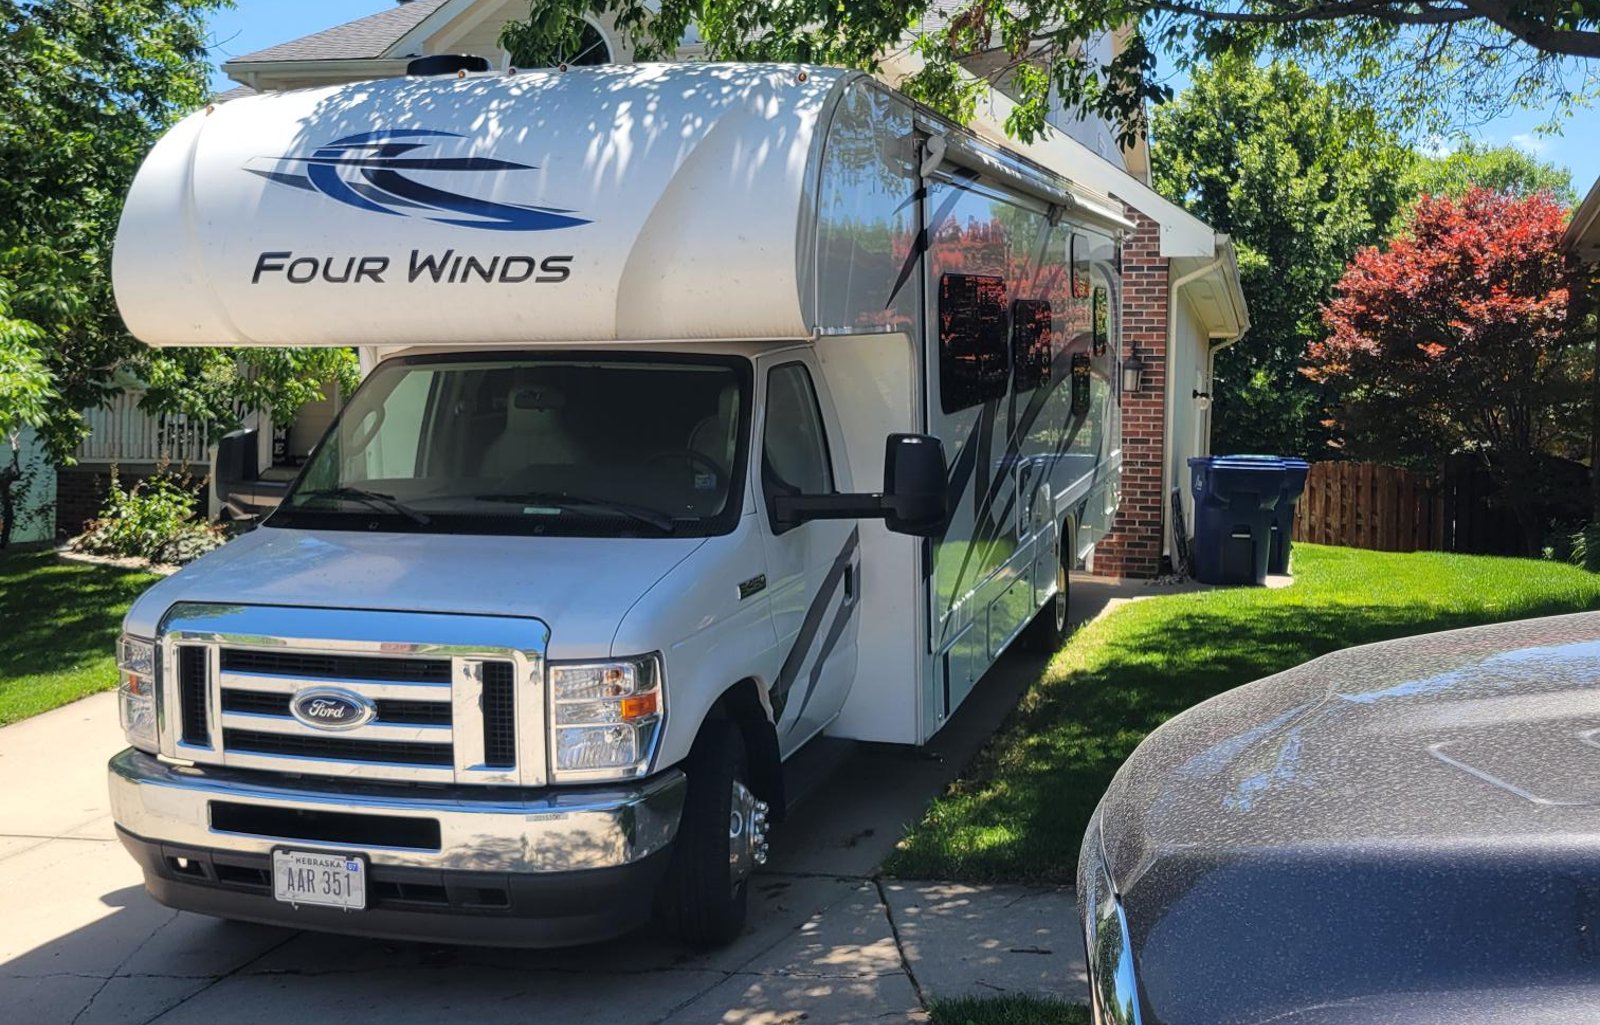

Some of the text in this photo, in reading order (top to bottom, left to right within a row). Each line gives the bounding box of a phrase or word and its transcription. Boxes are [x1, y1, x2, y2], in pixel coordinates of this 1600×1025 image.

[252, 249, 574, 284] FOUR WINDS
[309, 699, 345, 719] Ford
[296, 857, 342, 868] NEBRASKA
[287, 867, 351, 898] AAR 351
